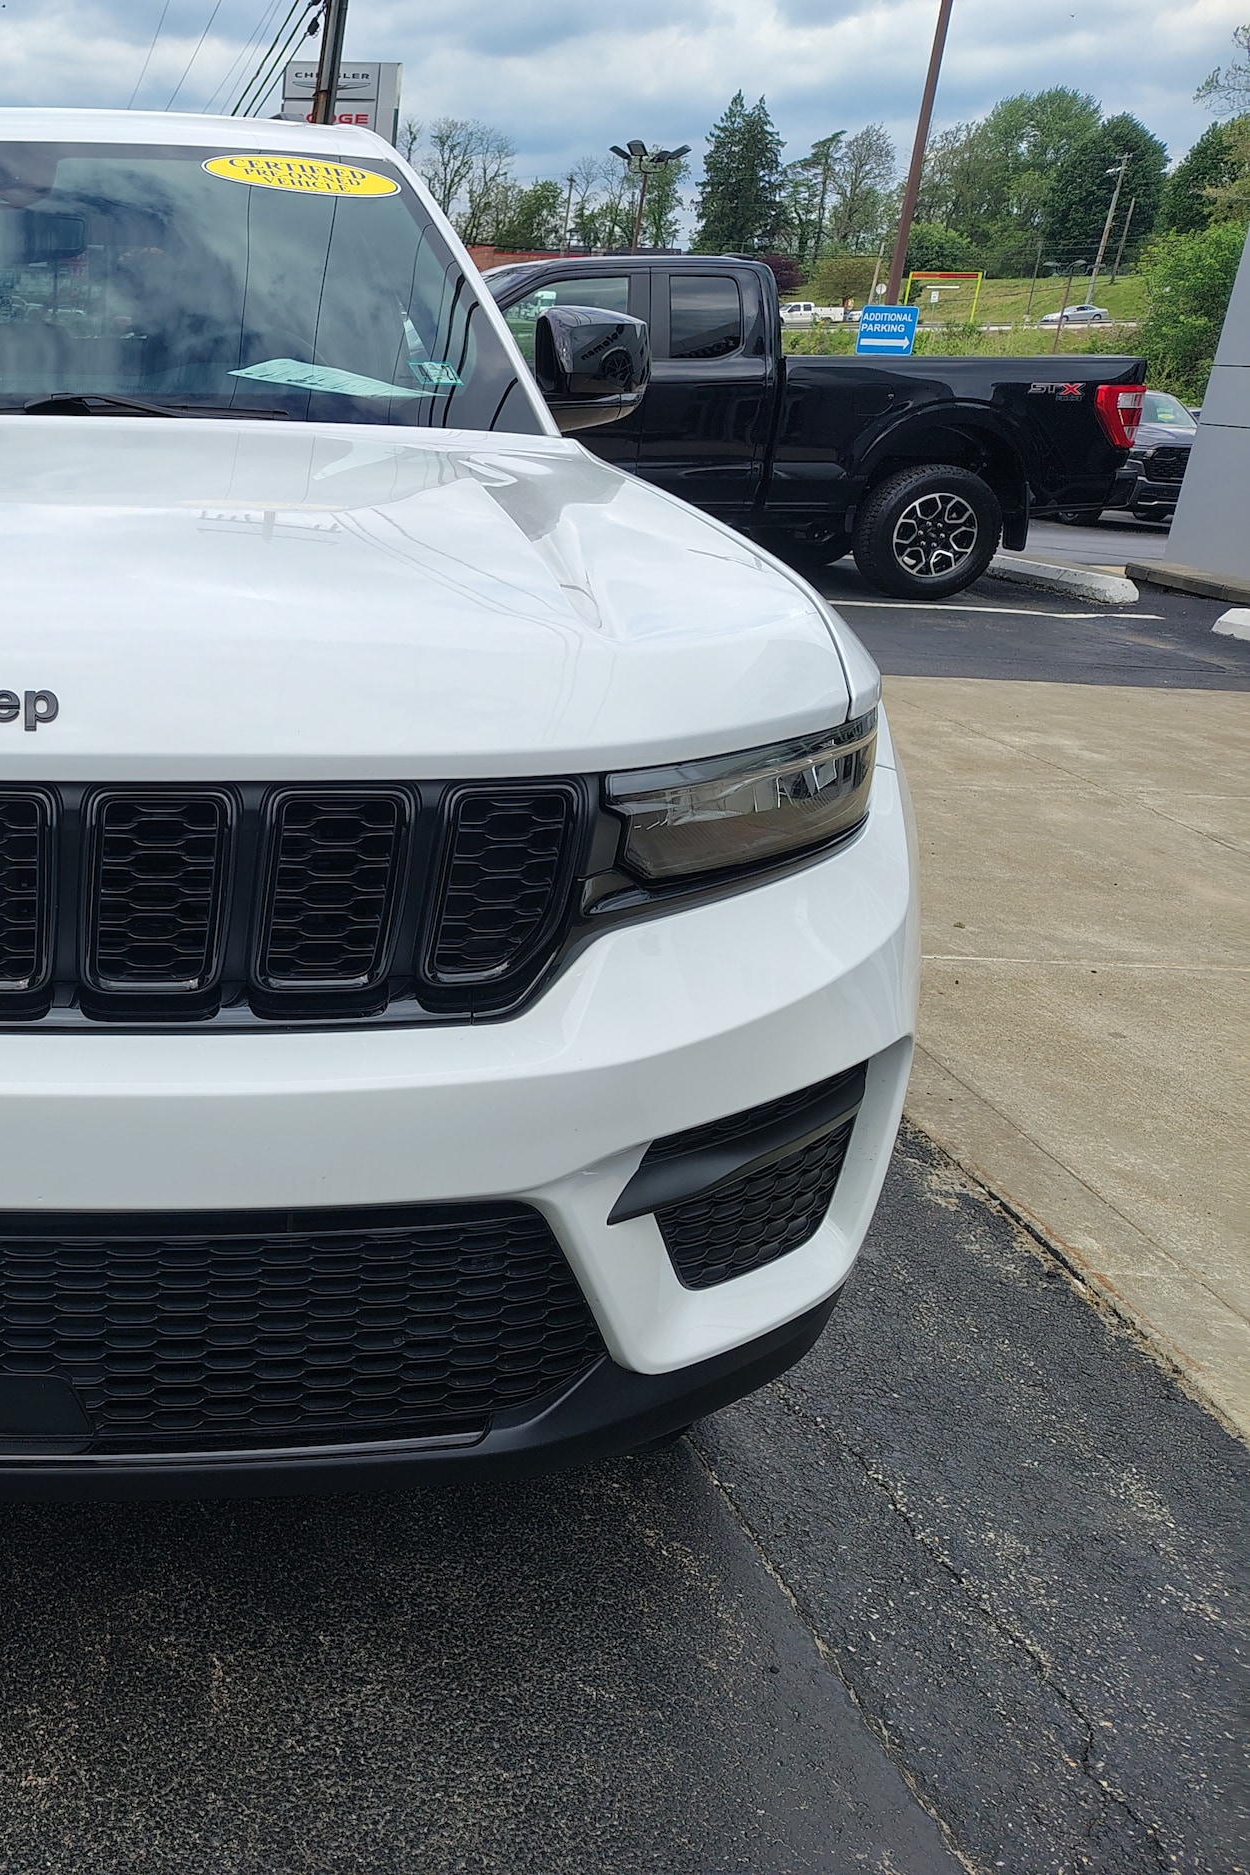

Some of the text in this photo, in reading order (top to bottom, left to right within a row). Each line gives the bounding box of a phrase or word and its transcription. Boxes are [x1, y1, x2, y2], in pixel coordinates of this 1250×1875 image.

[228, 158, 367, 180] CERTIFIED
[262, 176, 352, 192] VEHICLE
[862, 312, 913, 322] ADDITIONAL
[860, 323, 905, 333] PARKING
[1027, 382, 1086, 396] STX
